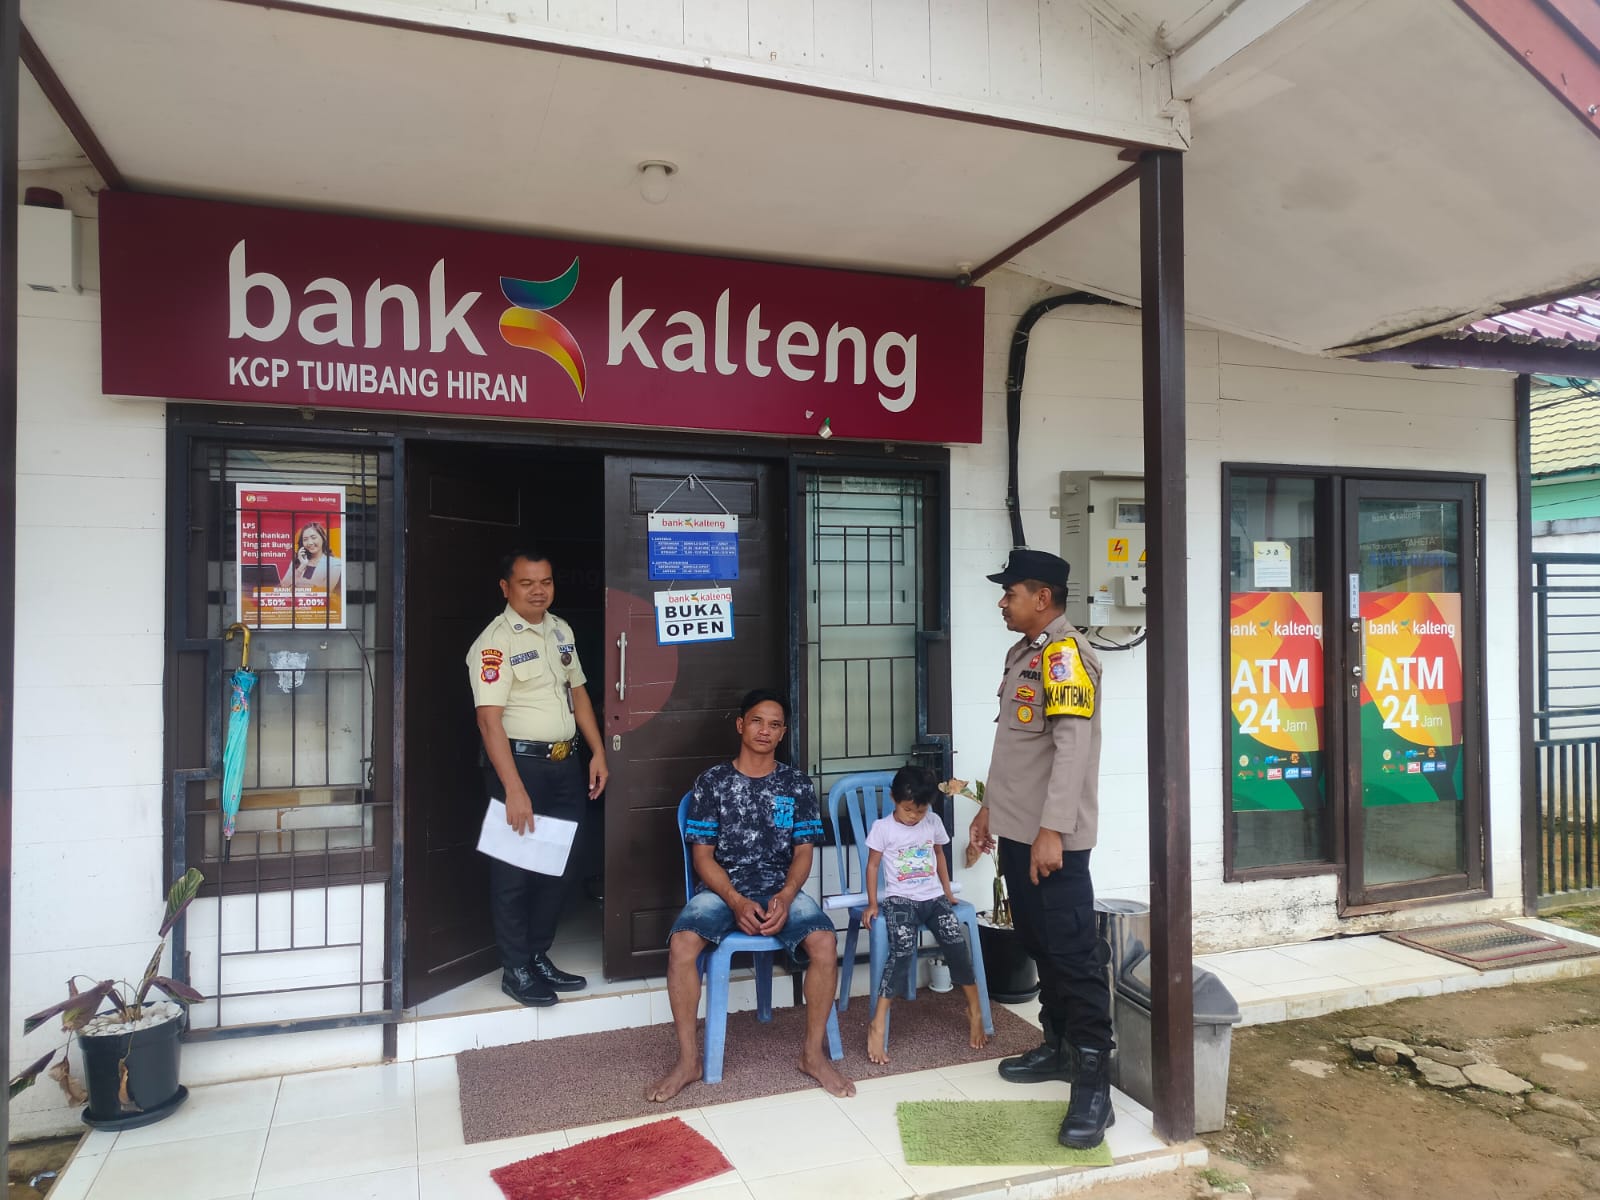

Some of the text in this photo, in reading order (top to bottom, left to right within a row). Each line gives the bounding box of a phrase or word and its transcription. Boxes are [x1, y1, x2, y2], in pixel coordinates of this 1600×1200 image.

[228, 239, 918, 413] bank kalteng
[228, 356, 528, 403] KCP TUMBANG HIRAN
[662, 518, 726, 529] bank kalteng
[242, 531, 290, 539] Perthankan
[242, 551, 287, 559] Penjminan
[668, 592, 732, 603] bank kalteng
[665, 603, 723, 619] BUKA
[666, 621, 724, 637] OPEN
[1231, 620, 1322, 639] ank kalteng
[1369, 620, 1456, 639] bank kalteng
[1231, 658, 1309, 694] ATM
[1375, 656, 1444, 691] ATM
[1238, 698, 1308, 734] 24 Jam
[1382, 694, 1443, 730] 24 Jam
